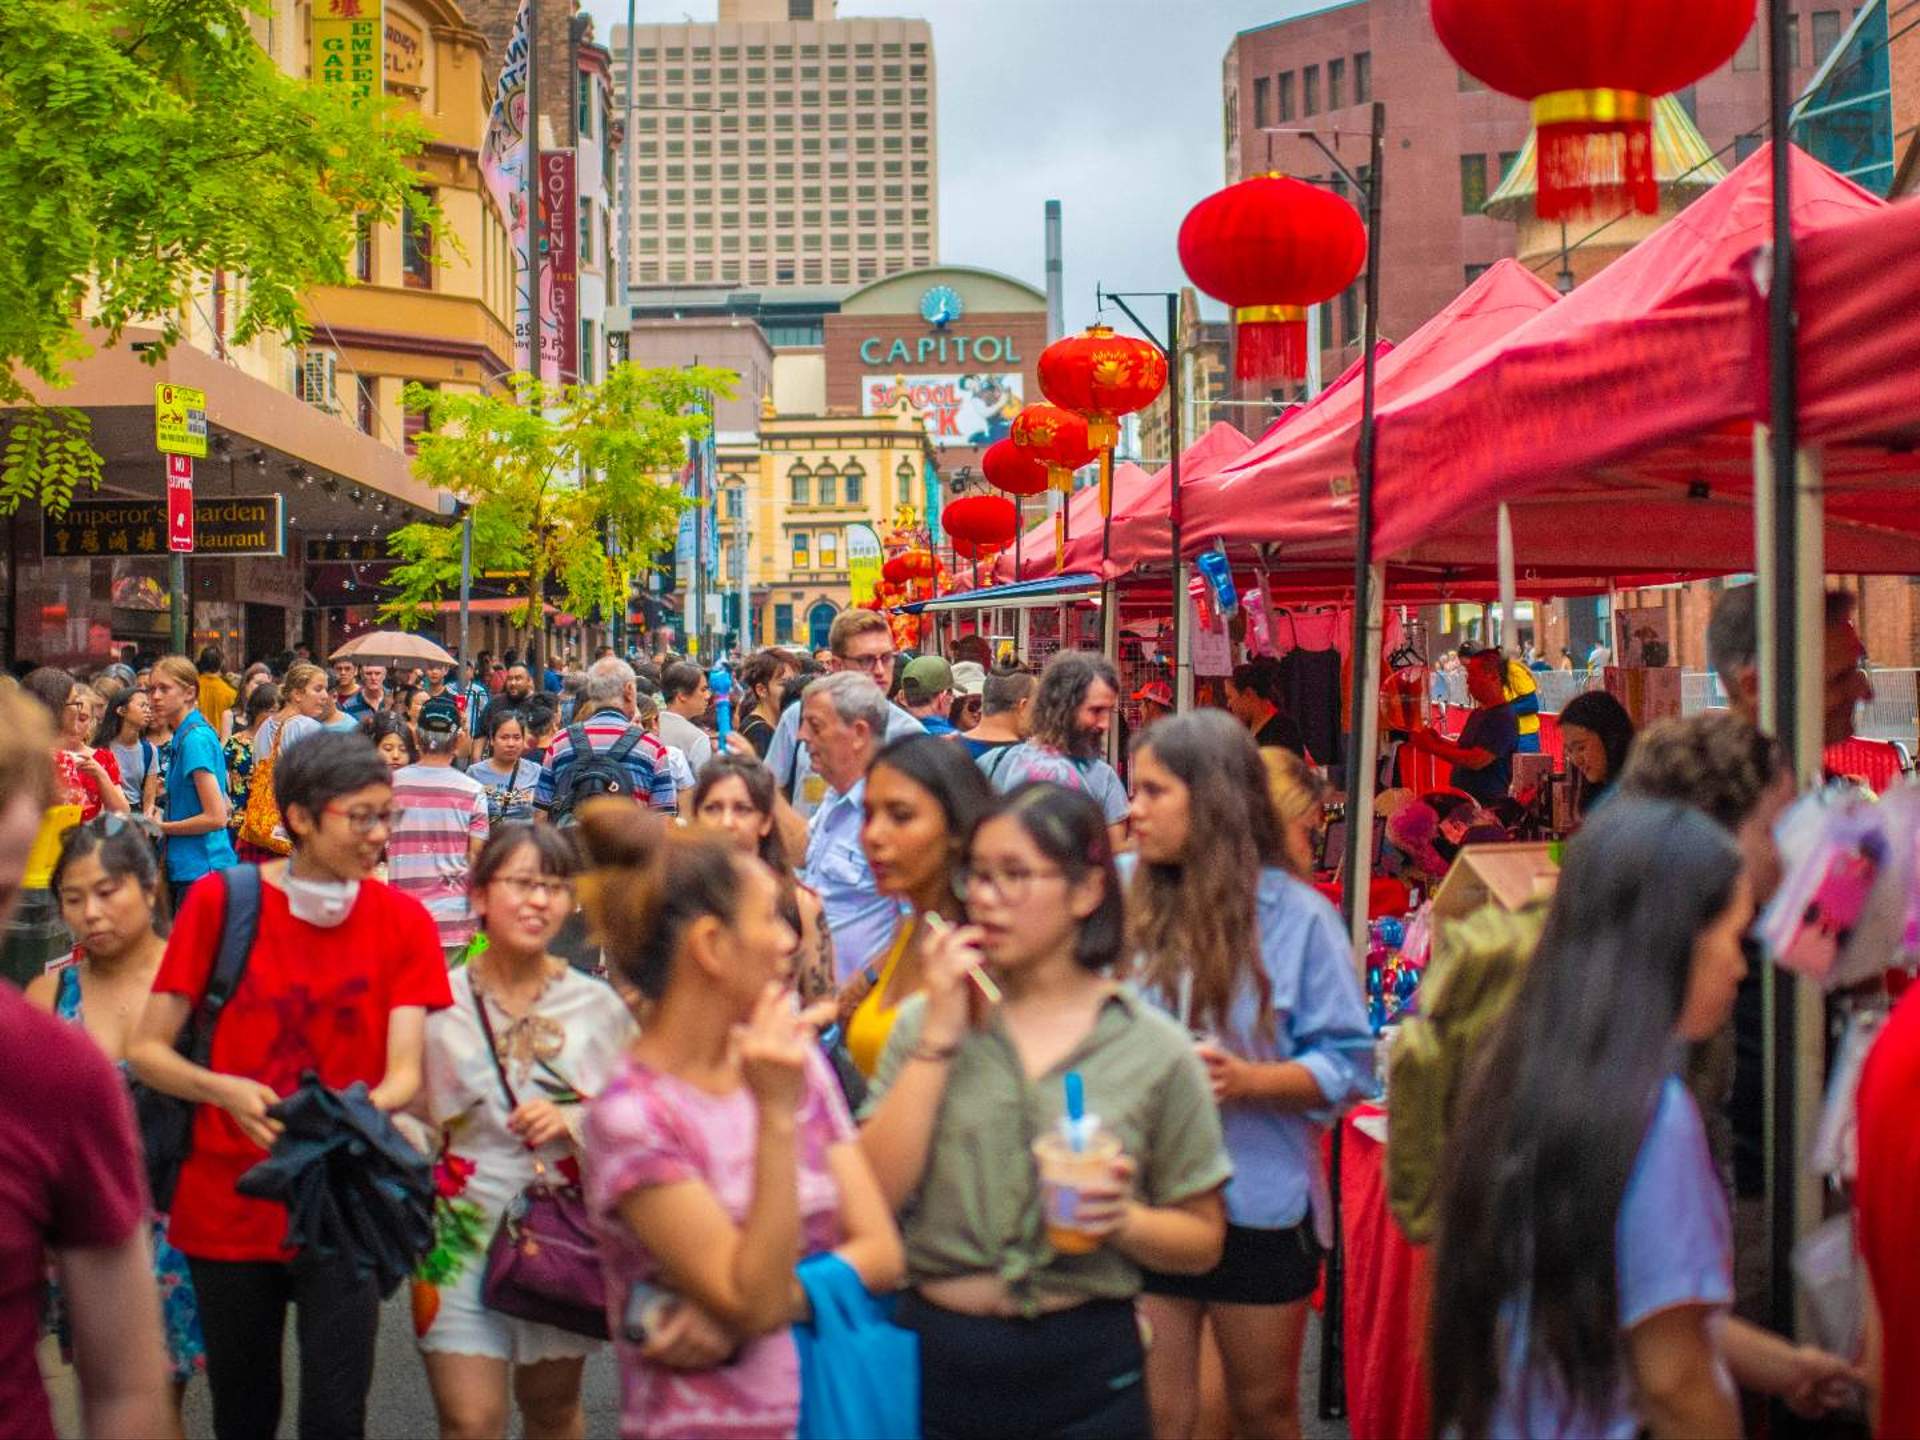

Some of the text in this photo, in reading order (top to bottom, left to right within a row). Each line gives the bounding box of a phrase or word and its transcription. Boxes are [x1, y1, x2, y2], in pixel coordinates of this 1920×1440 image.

[323, 38, 344, 82] GAR
[549, 156, 564, 268] COVENT
[860, 336, 1021, 364] CAPITOL
[175, 457, 184, 472] NO
[55, 502, 265, 529] mperor's arden
